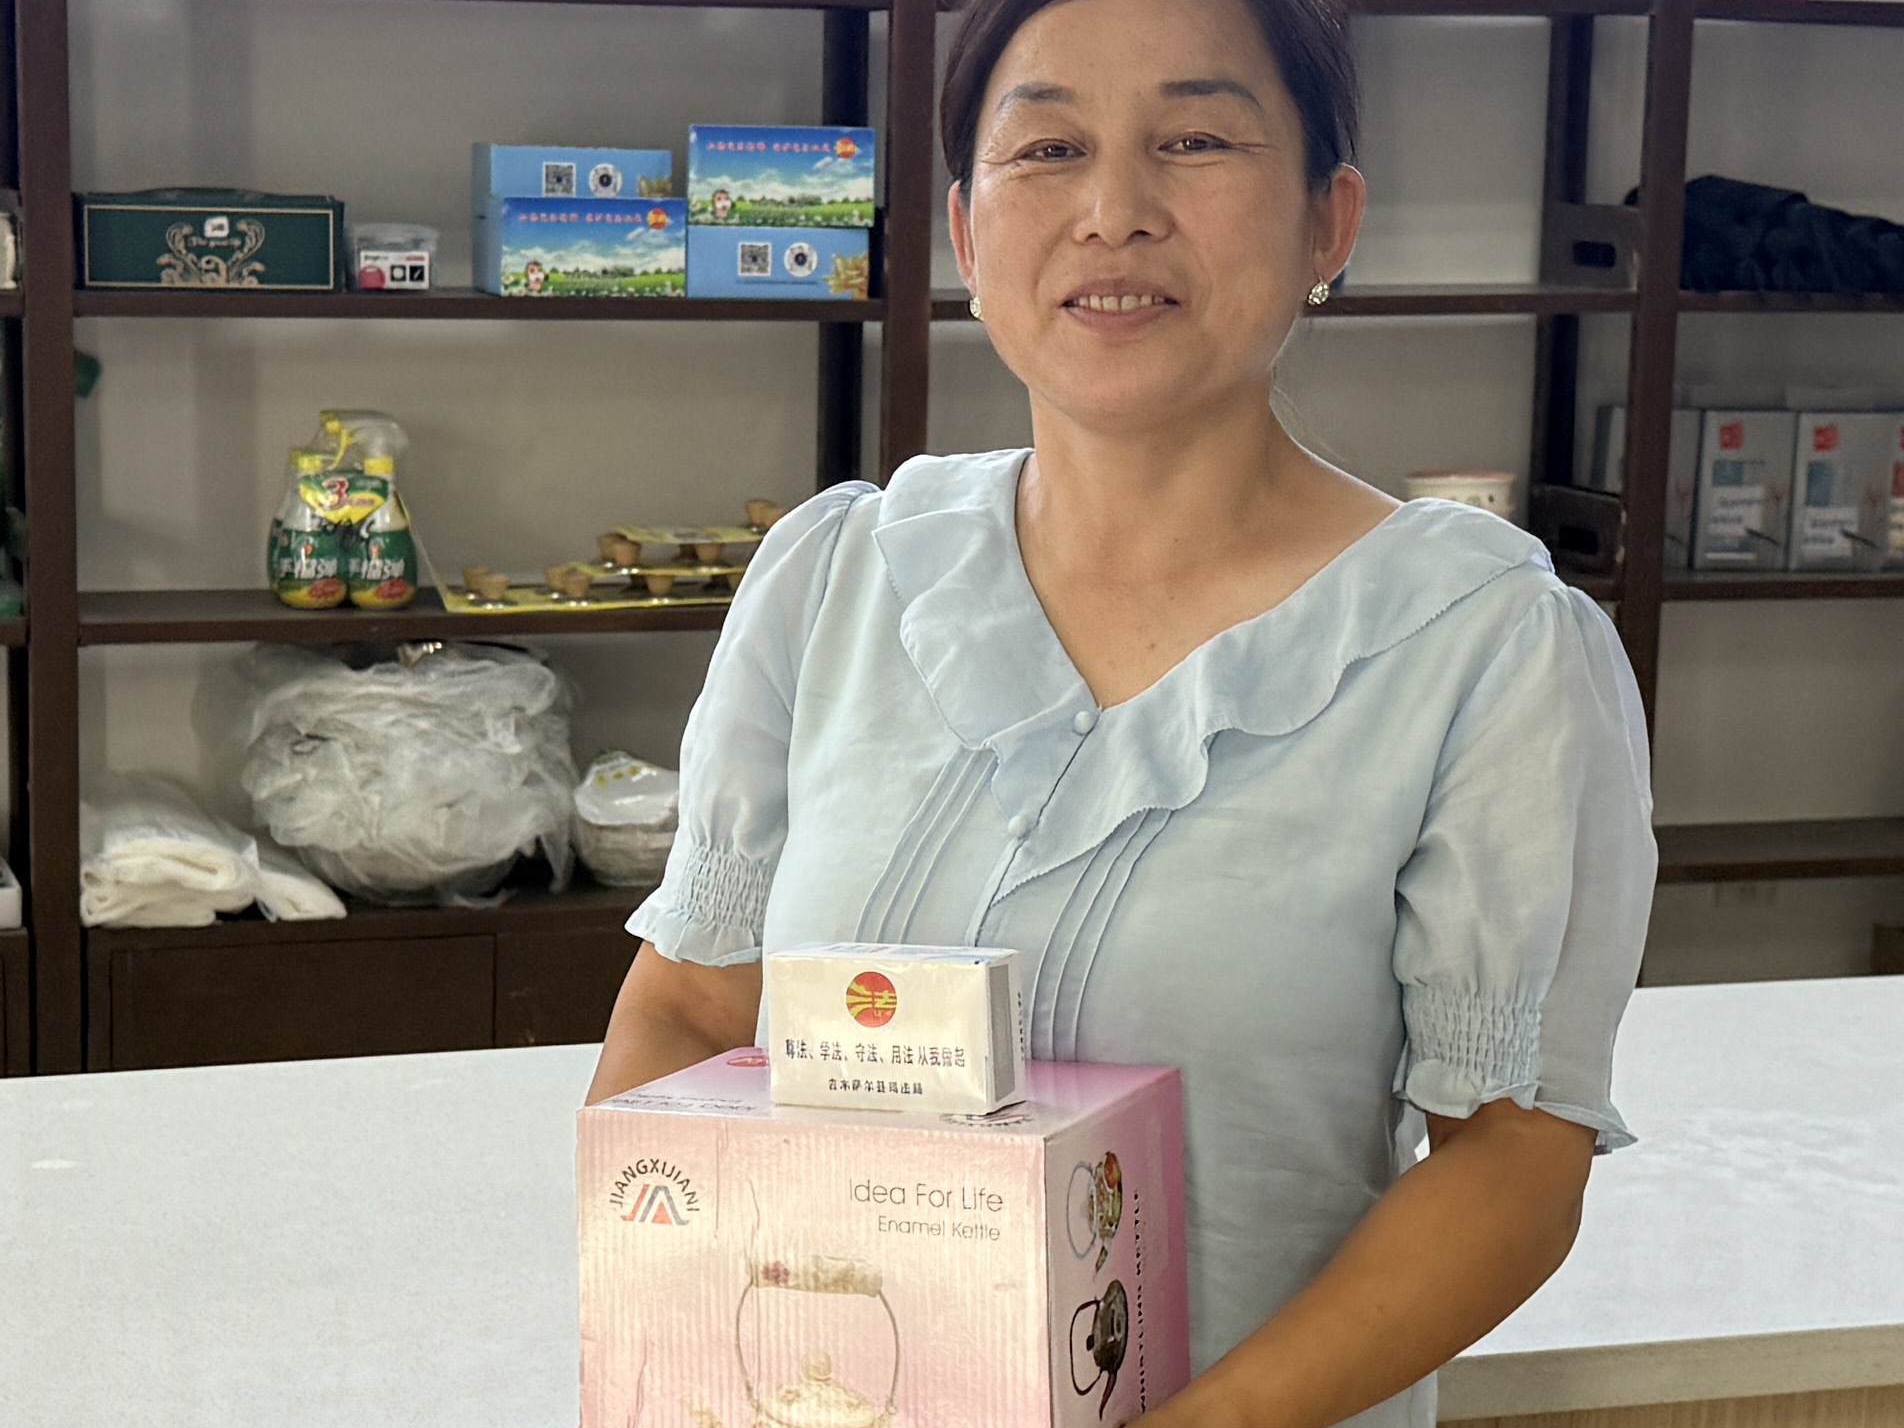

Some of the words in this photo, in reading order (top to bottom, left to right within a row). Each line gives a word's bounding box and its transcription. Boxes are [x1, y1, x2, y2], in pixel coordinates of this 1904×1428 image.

[849, 1178, 906, 1205] Idea
[915, 1182, 953, 1209] For
[961, 1185, 1004, 1212] Life
[878, 1215, 946, 1237] Enamel
[951, 1221, 1001, 1241] Kettle
